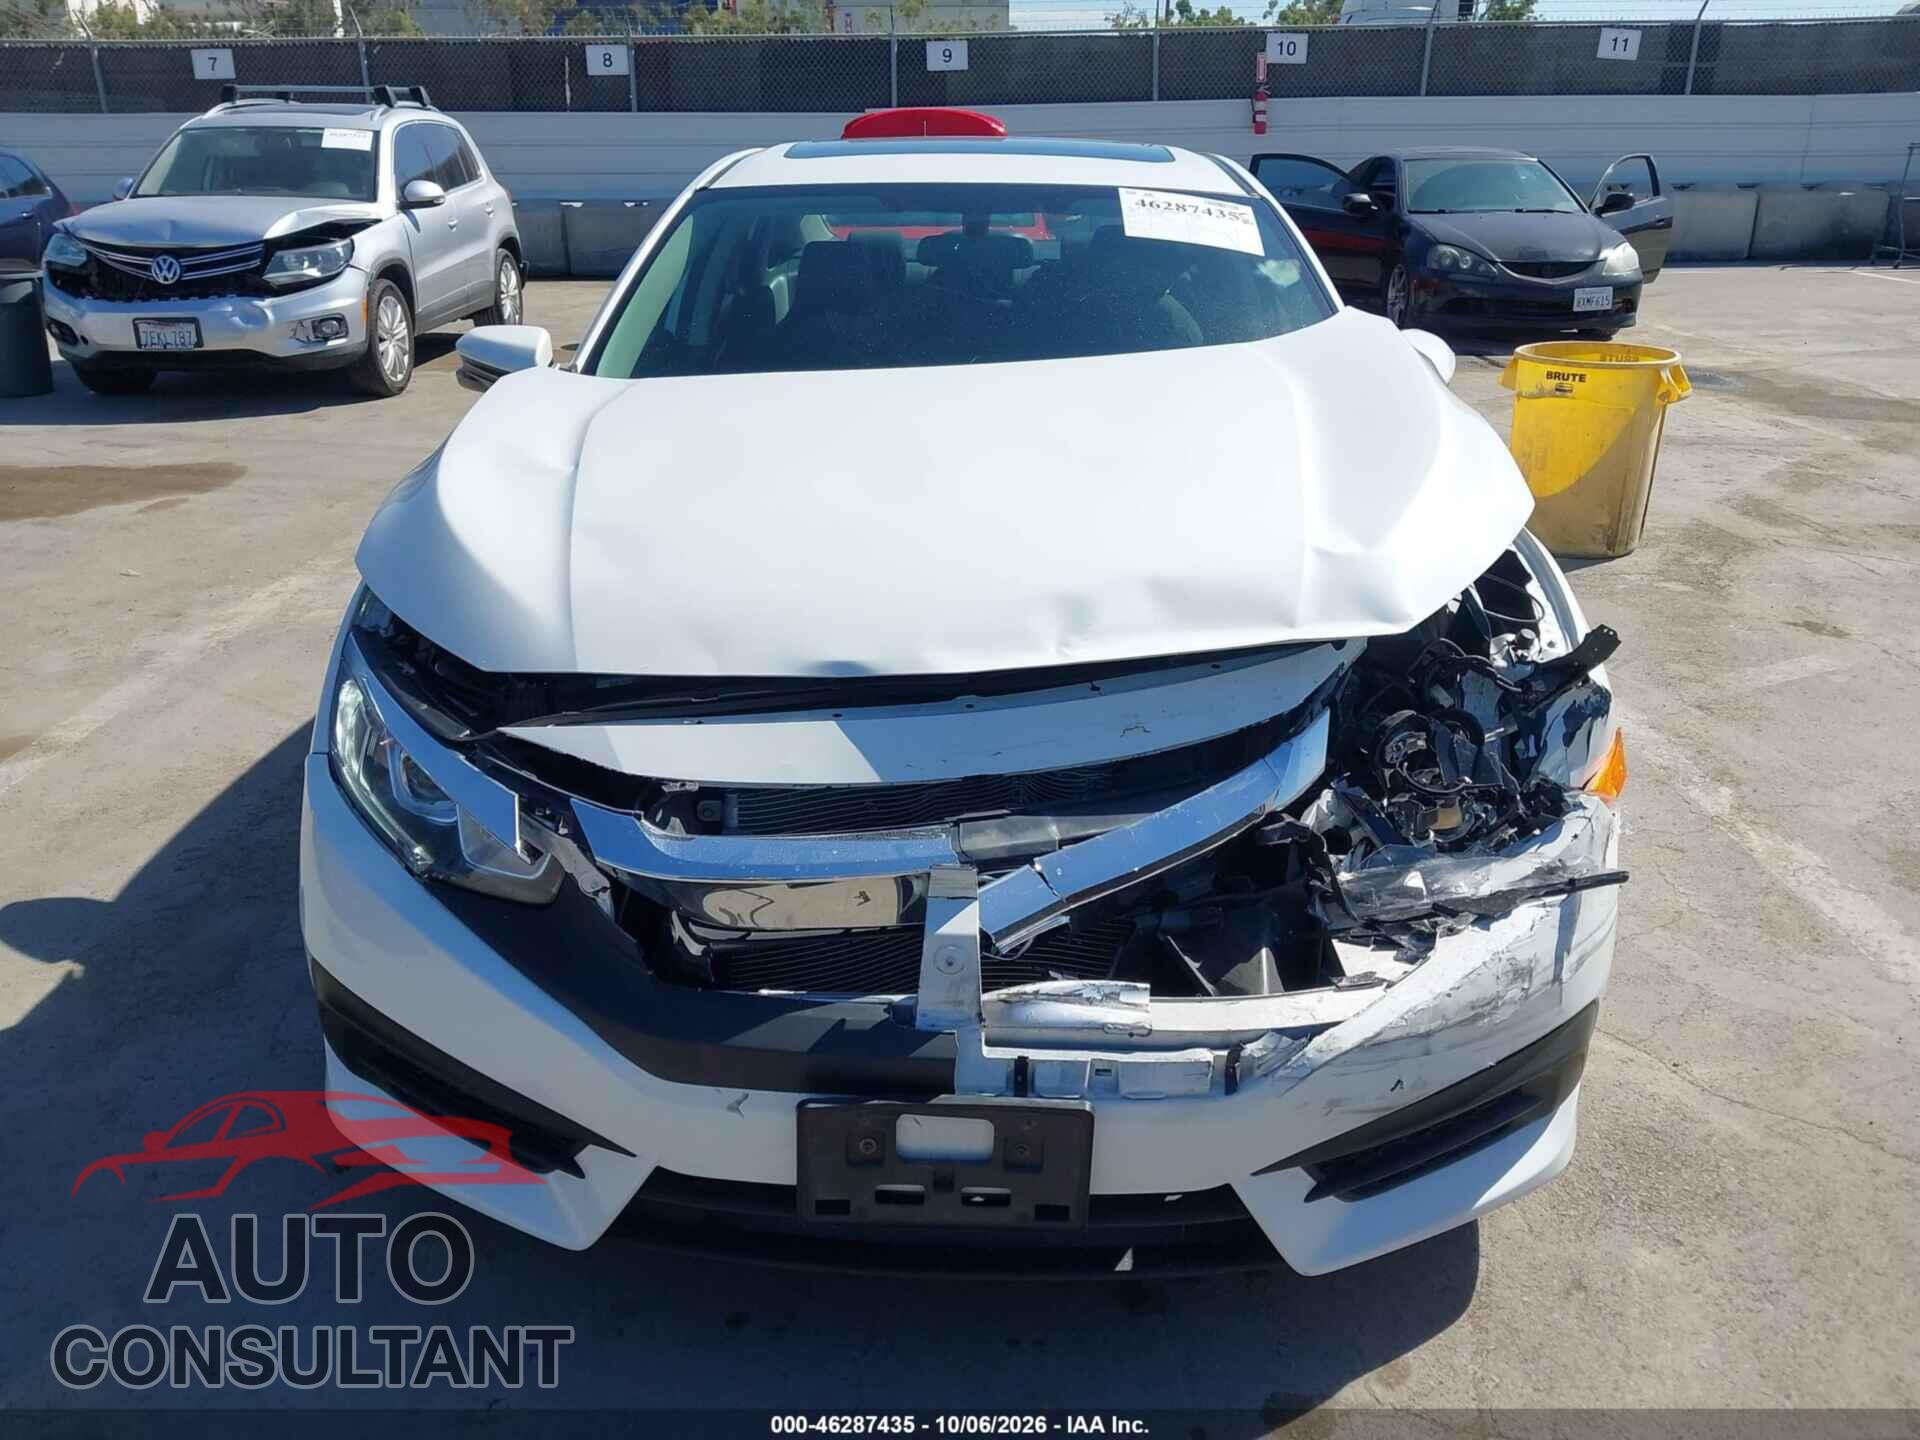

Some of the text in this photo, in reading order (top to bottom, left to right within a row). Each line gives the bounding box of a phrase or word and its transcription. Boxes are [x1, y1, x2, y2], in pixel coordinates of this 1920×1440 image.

[1277, 41, 1297, 56] 10
[1611, 36, 1629, 51] 11
[602, 52, 613, 68] 8
[942, 48, 952, 63] 9
[207, 56, 217, 71] 7
[1135, 199, 1242, 222] 46287435
[1546, 370, 1587, 382] BRUTE
